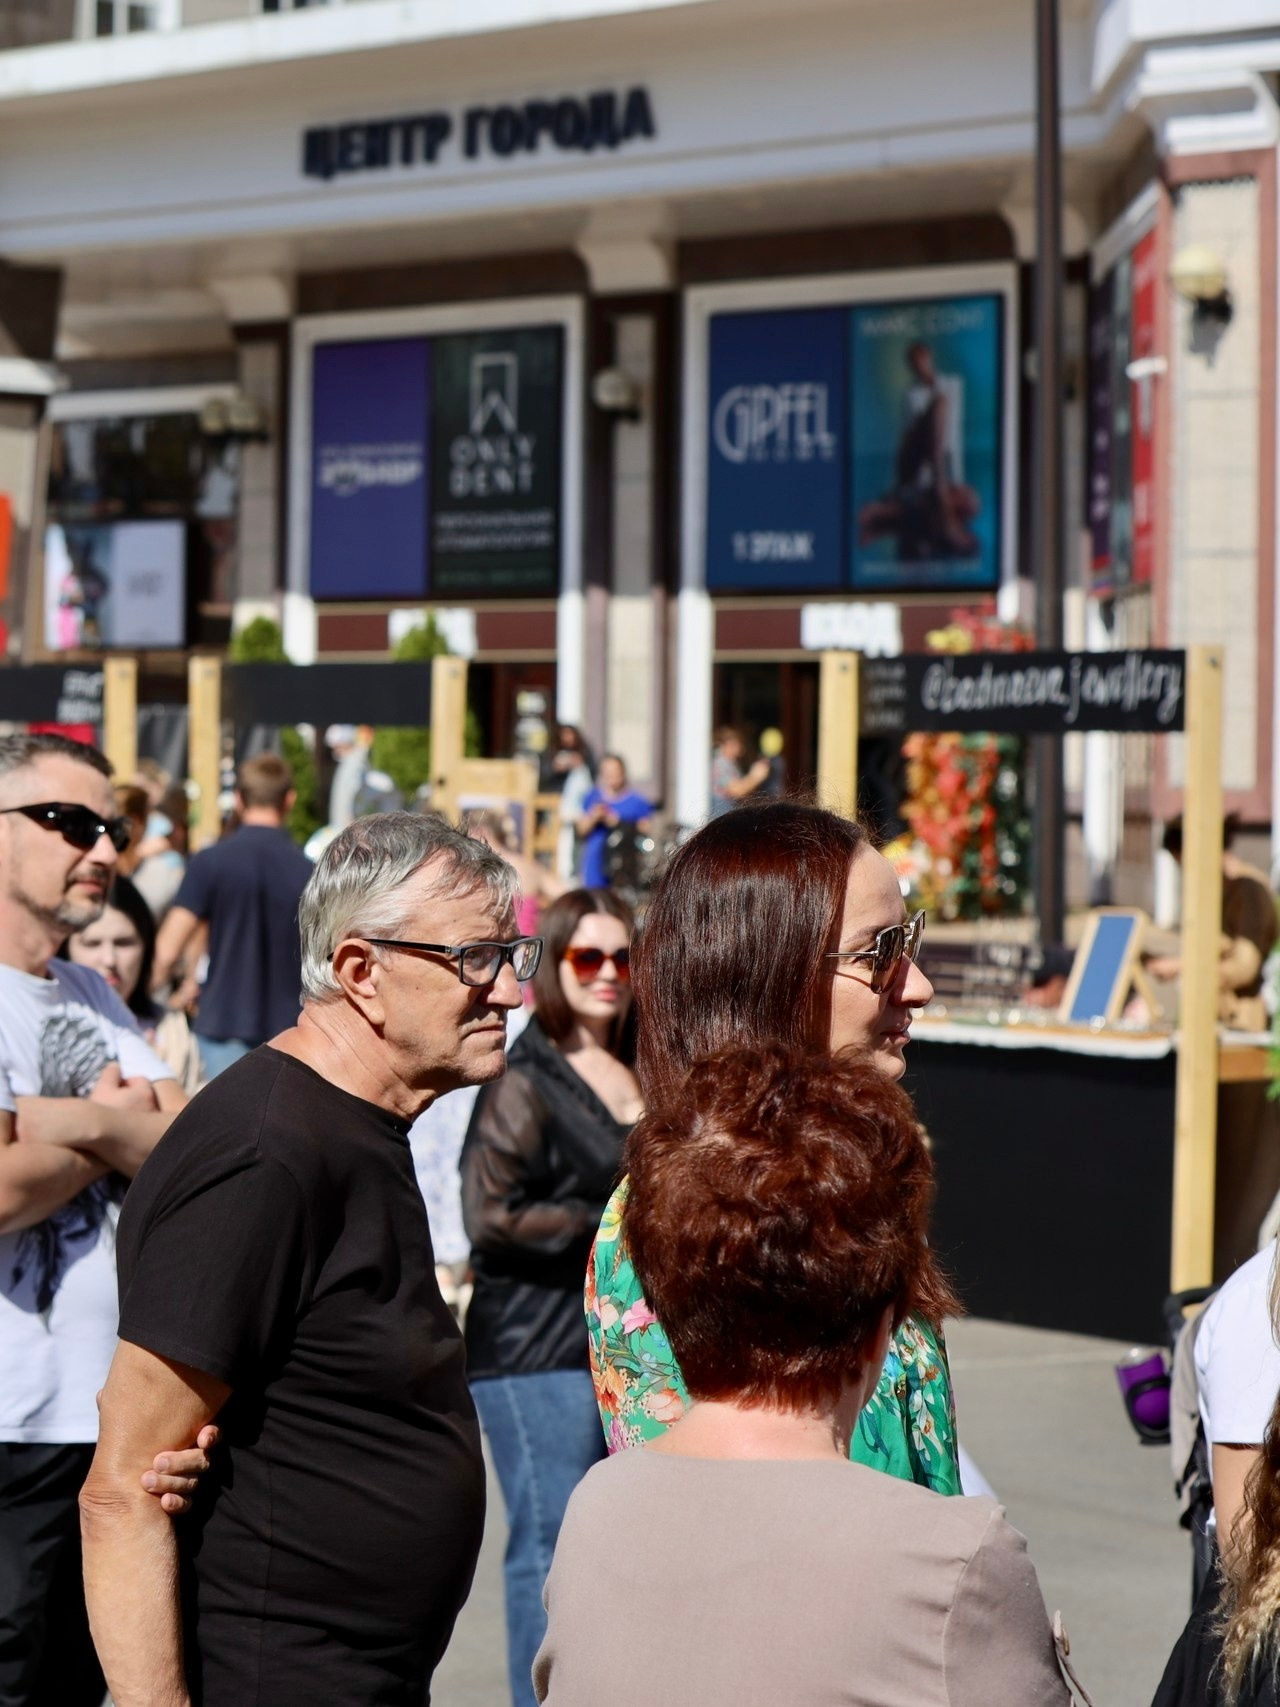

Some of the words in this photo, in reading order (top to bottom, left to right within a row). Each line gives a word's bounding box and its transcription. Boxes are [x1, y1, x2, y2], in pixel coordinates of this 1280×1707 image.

[304, 113, 452, 180] ЦЕНТР
[465, 87, 655, 158] ГОРОДА
[451, 435, 534, 466] ONLY
[451, 464, 532, 496] DENT
[733, 533, 745, 562] 1
[750, 530, 813, 561] ЭТАЖ
